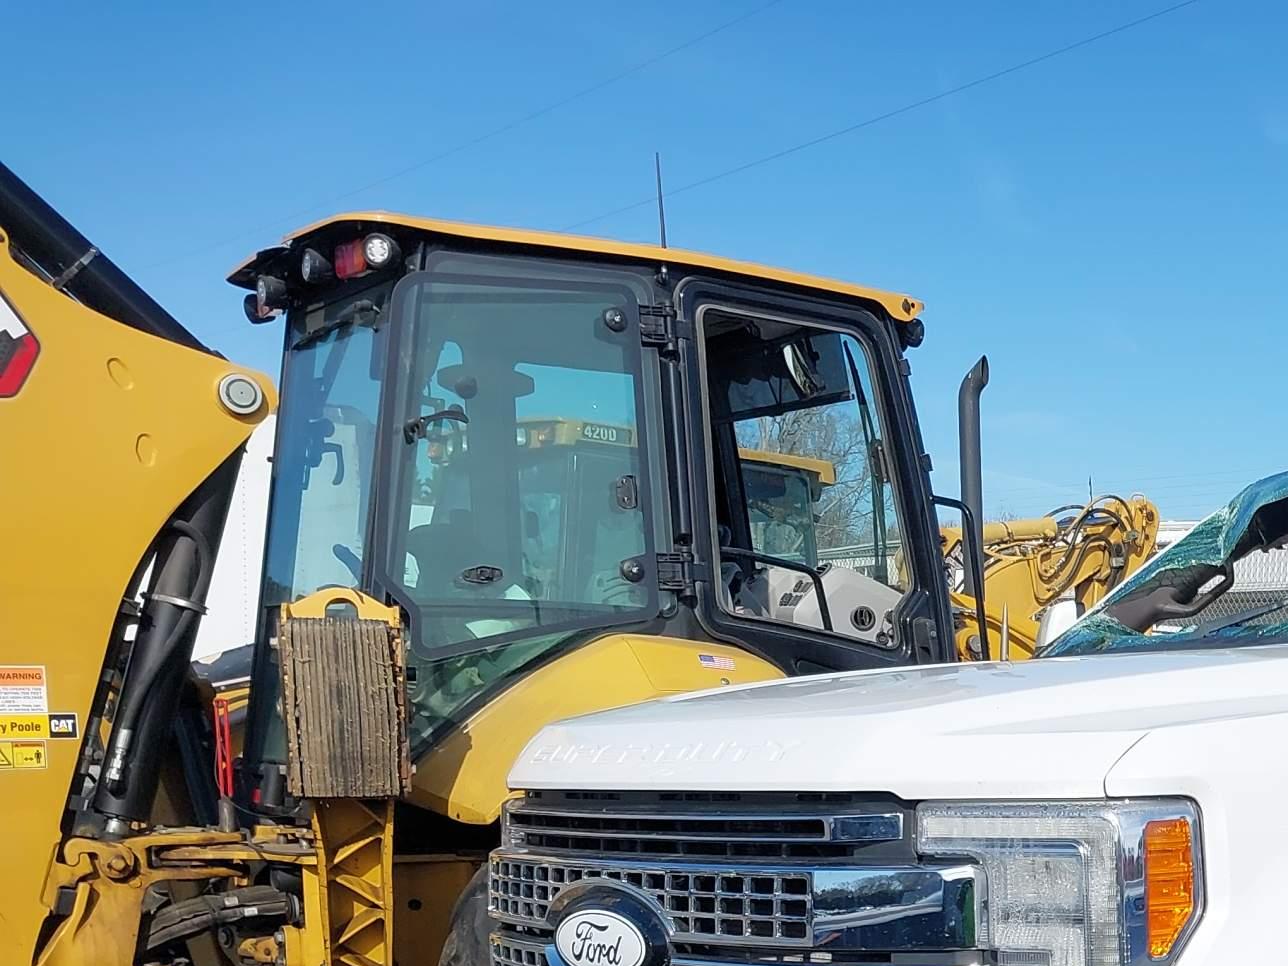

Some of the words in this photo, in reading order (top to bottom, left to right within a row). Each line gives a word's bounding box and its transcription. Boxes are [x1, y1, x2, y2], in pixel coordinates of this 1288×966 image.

[584, 425, 617, 441] 420D
[10, 722, 41, 732] Poole
[51, 720, 74, 732] CAT
[572, 921, 622, 966] Ford
